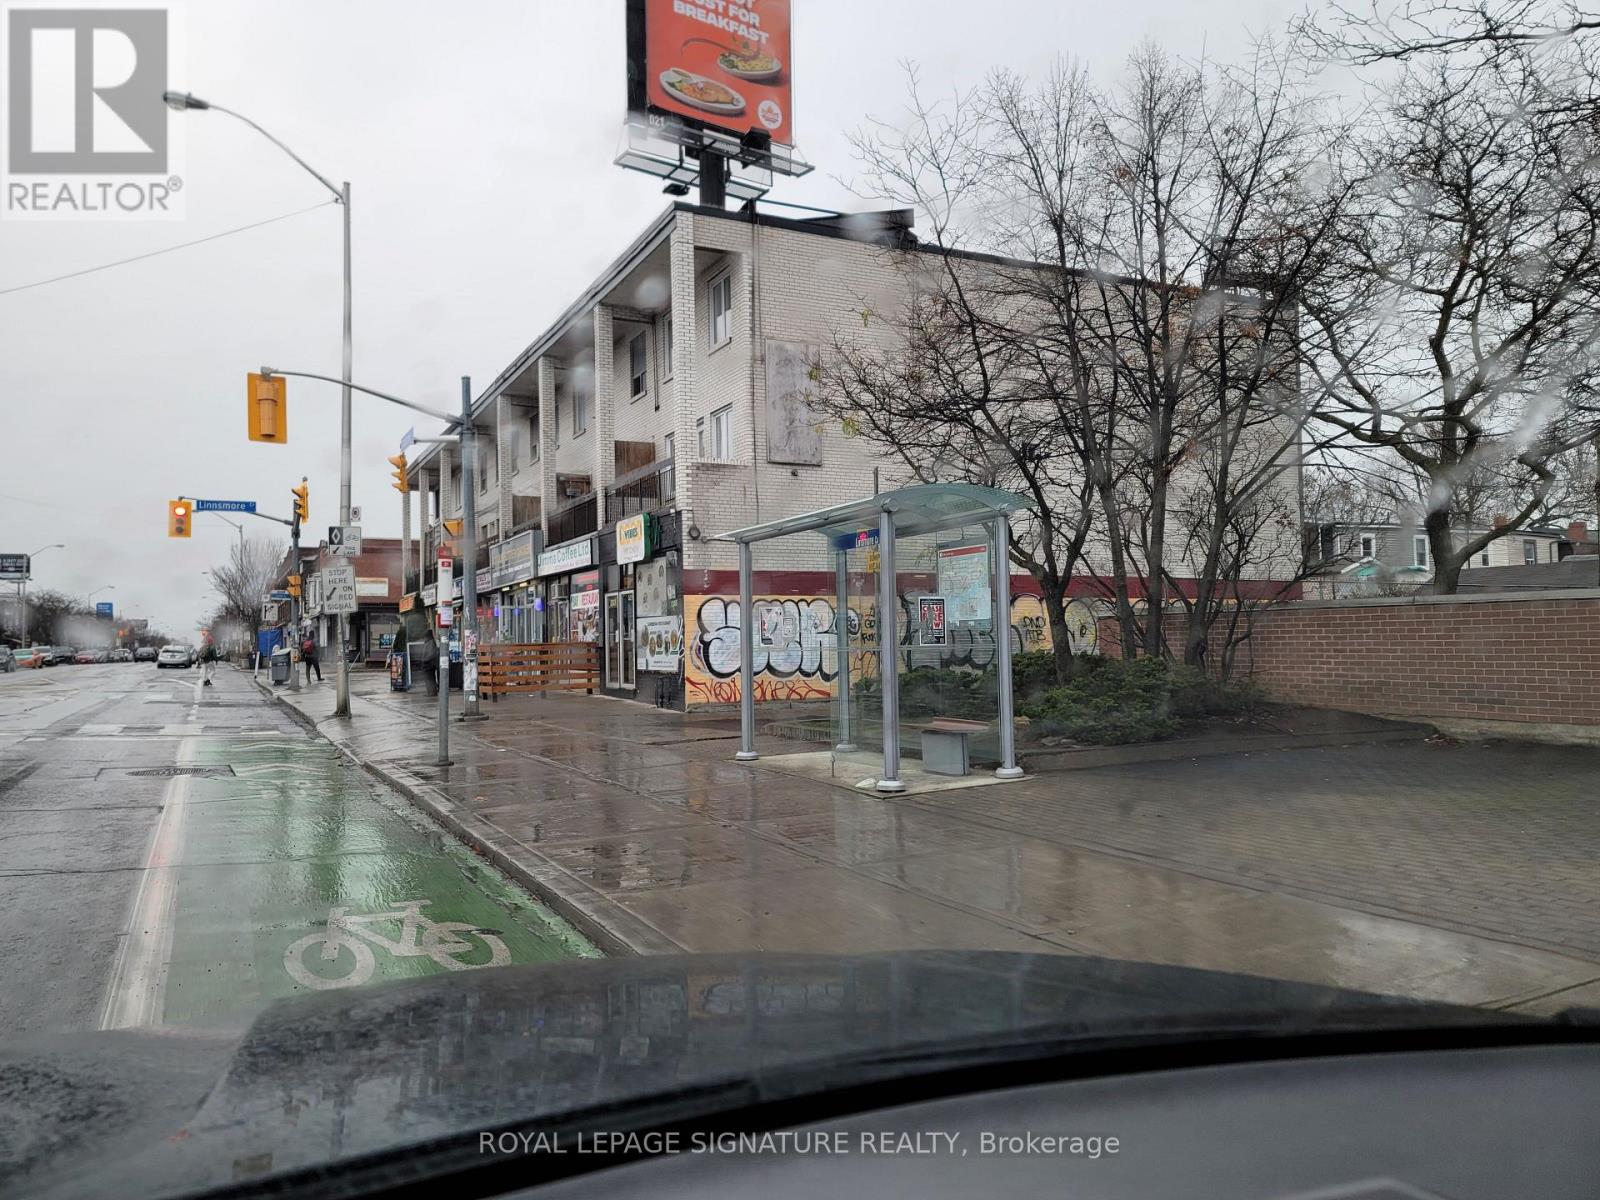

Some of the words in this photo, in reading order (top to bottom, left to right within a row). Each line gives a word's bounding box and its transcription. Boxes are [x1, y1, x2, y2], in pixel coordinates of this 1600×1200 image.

[686, 0, 726, 12] ST
[728, 4, 760, 27] FOR
[673, 0, 769, 44] BREAKFAST
[199, 501, 246, 510] Linnsmore
[556, 546, 577, 563] Coffee
[577, 541, 589, 556] Ltd
[328, 577, 348, 585] HERE
[327, 602, 353, 611] SIGNAL
